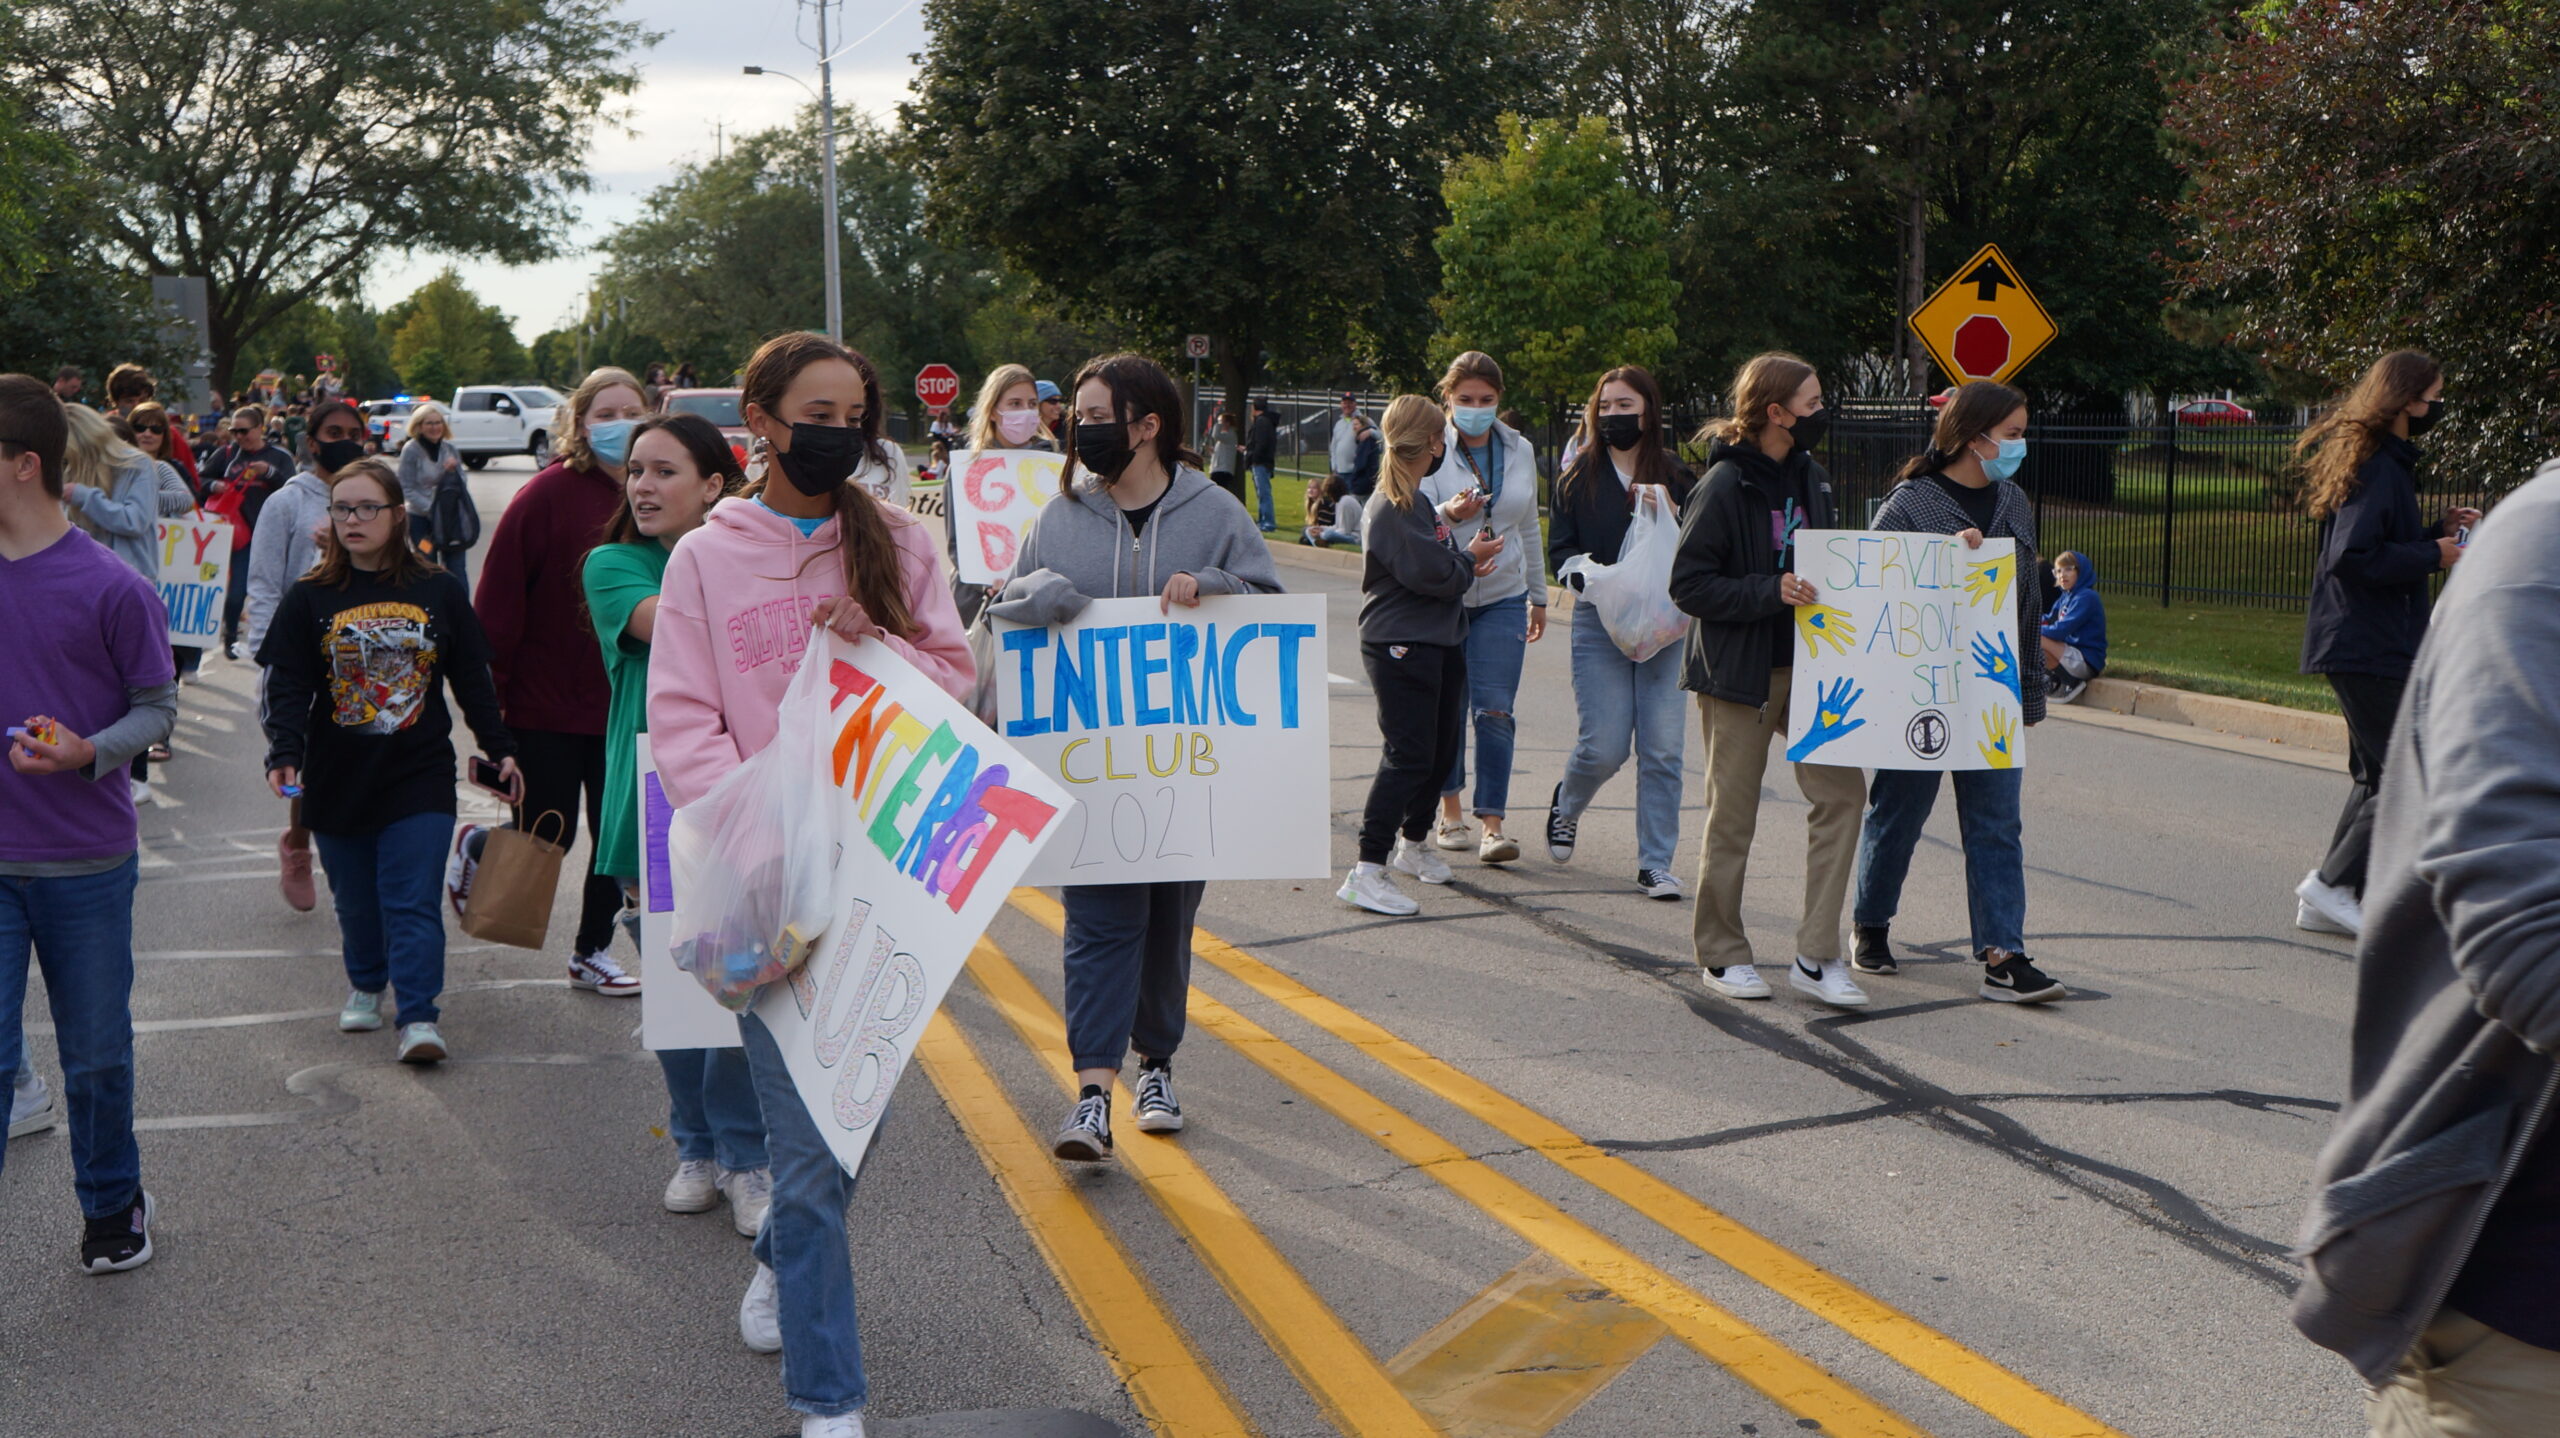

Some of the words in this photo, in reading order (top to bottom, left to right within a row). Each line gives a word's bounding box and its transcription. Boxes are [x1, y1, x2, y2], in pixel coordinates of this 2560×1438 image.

[919, 377, 956, 395] STOP
[1825, 536, 1960, 591] SERVICE
[329, 601, 430, 634] HOLLYWOOD
[1865, 601, 1965, 658] ABOVE
[1002, 622, 1316, 737] INTERACT
[1911, 661, 1962, 706] SELF
[830, 658, 1058, 914] INTERACT
[1060, 732, 1220, 784] CLUB
[1069, 784, 1215, 869] 2021
[788, 898, 927, 1131] UB
